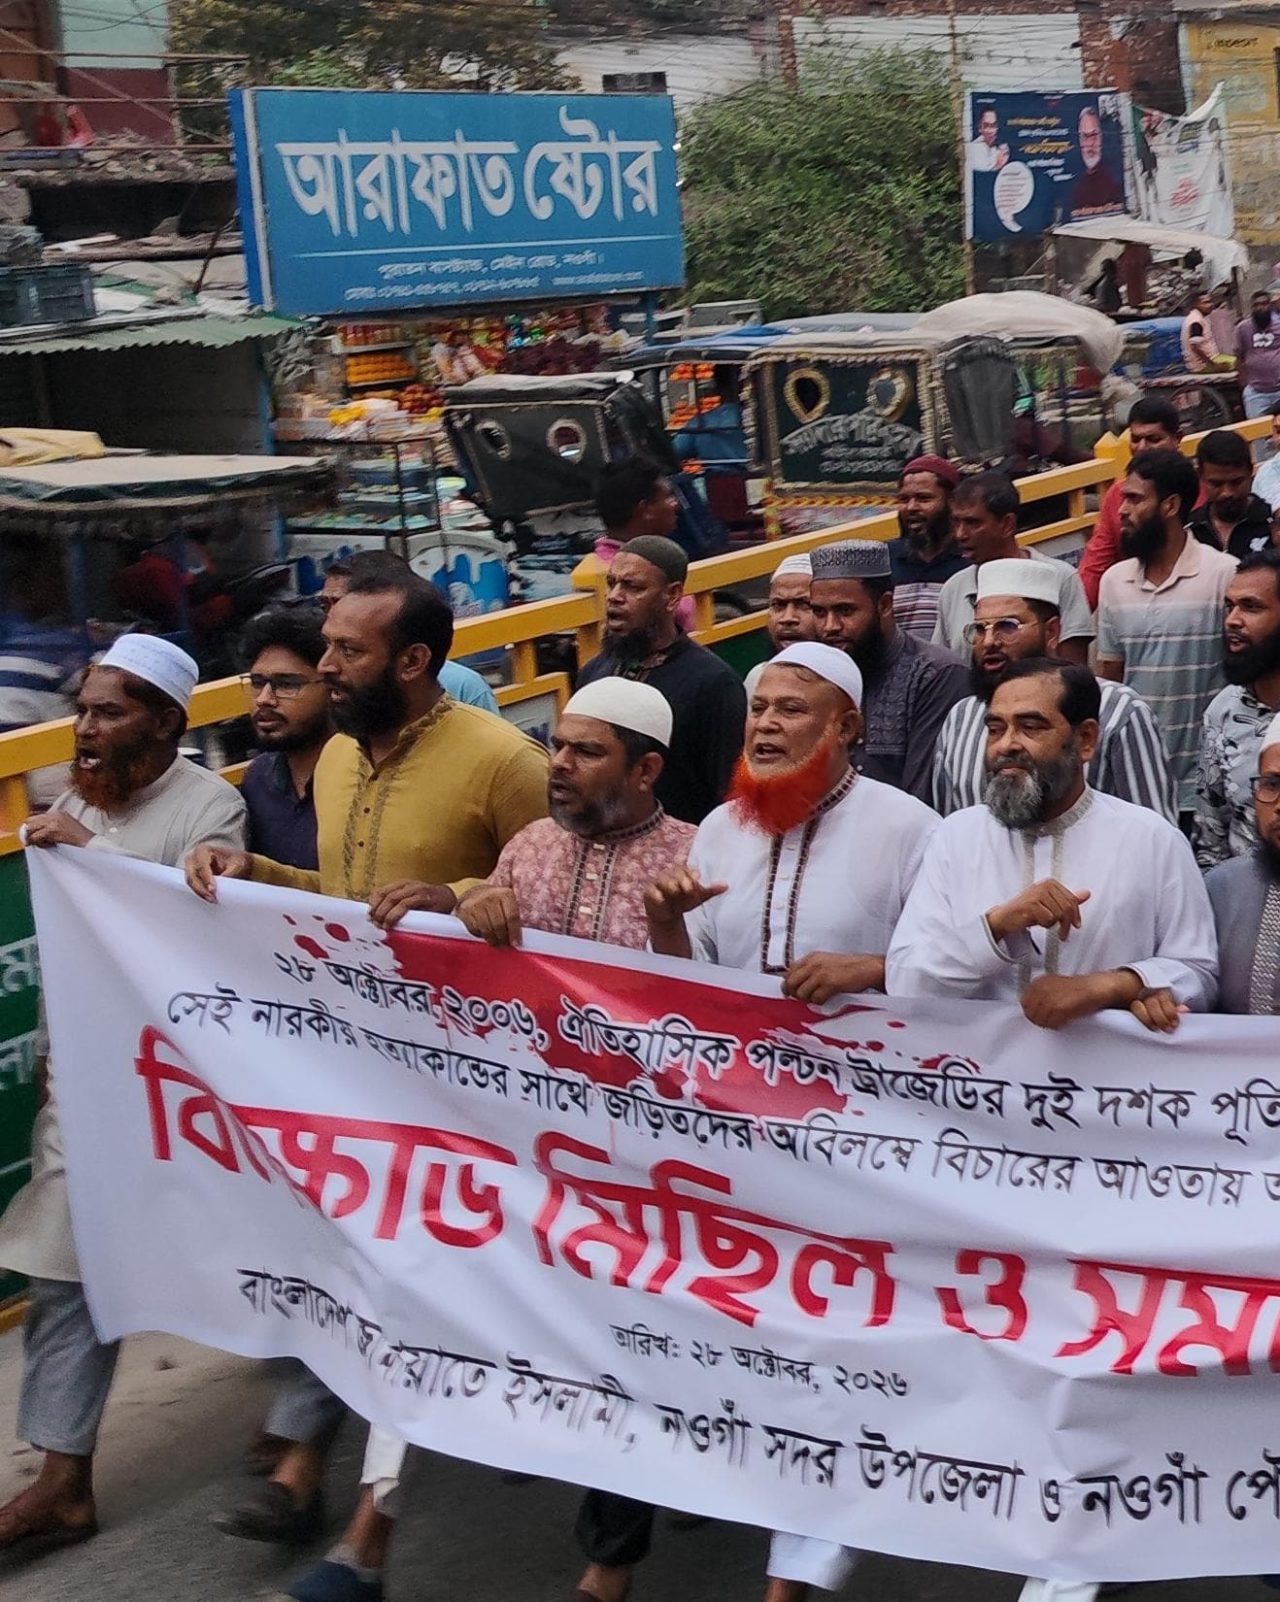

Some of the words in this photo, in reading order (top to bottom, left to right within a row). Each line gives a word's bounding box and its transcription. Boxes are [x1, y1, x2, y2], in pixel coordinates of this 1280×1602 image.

[275, 128, 518, 238] আরাফাত
[523, 104, 663, 222] ষ্টোর
[167, 981, 243, 1036] সেই
[248, 998, 360, 1049] নারকীয়
[518, 1068, 595, 1118] সাথে
[600, 1083, 756, 1153] জড়িতদের
[764, 1113, 924, 1173] অবিলম্বে
[931, 1127, 1082, 1193] বিচারের
[1092, 1155, 1253, 1208] আওতায়
[274, 952, 316, 984] ২৮
[442, 986, 548, 1048] ২০০৬,
[561, 997, 736, 1074] ঐতিহাসিক
[749, 1040, 843, 1090] পল্টন
[846, 1050, 1011, 1117] ট্রাজেডির
[1019, 1071, 1084, 1129] দুই
[1092, 1082, 1196, 1130] দশক
[533, 1131, 898, 1328] মিছিল
[935, 1248, 1029, 1341] ও
[502, 1350, 643, 1453] ইসলামী,
[652, 1397, 753, 1469] নওগাঁ
[760, 1423, 849, 1488] সদর
[855, 1423, 1028, 1521] উপজেলা
[1039, 1477, 1064, 1522] ও
[1074, 1451, 1211, 1528] নওগাঁ
[690, 1340, 722, 1368] ২৮
[730, 1345, 821, 1394] অক্টোবর,
[833, 1364, 909, 1400] ২০২৬
